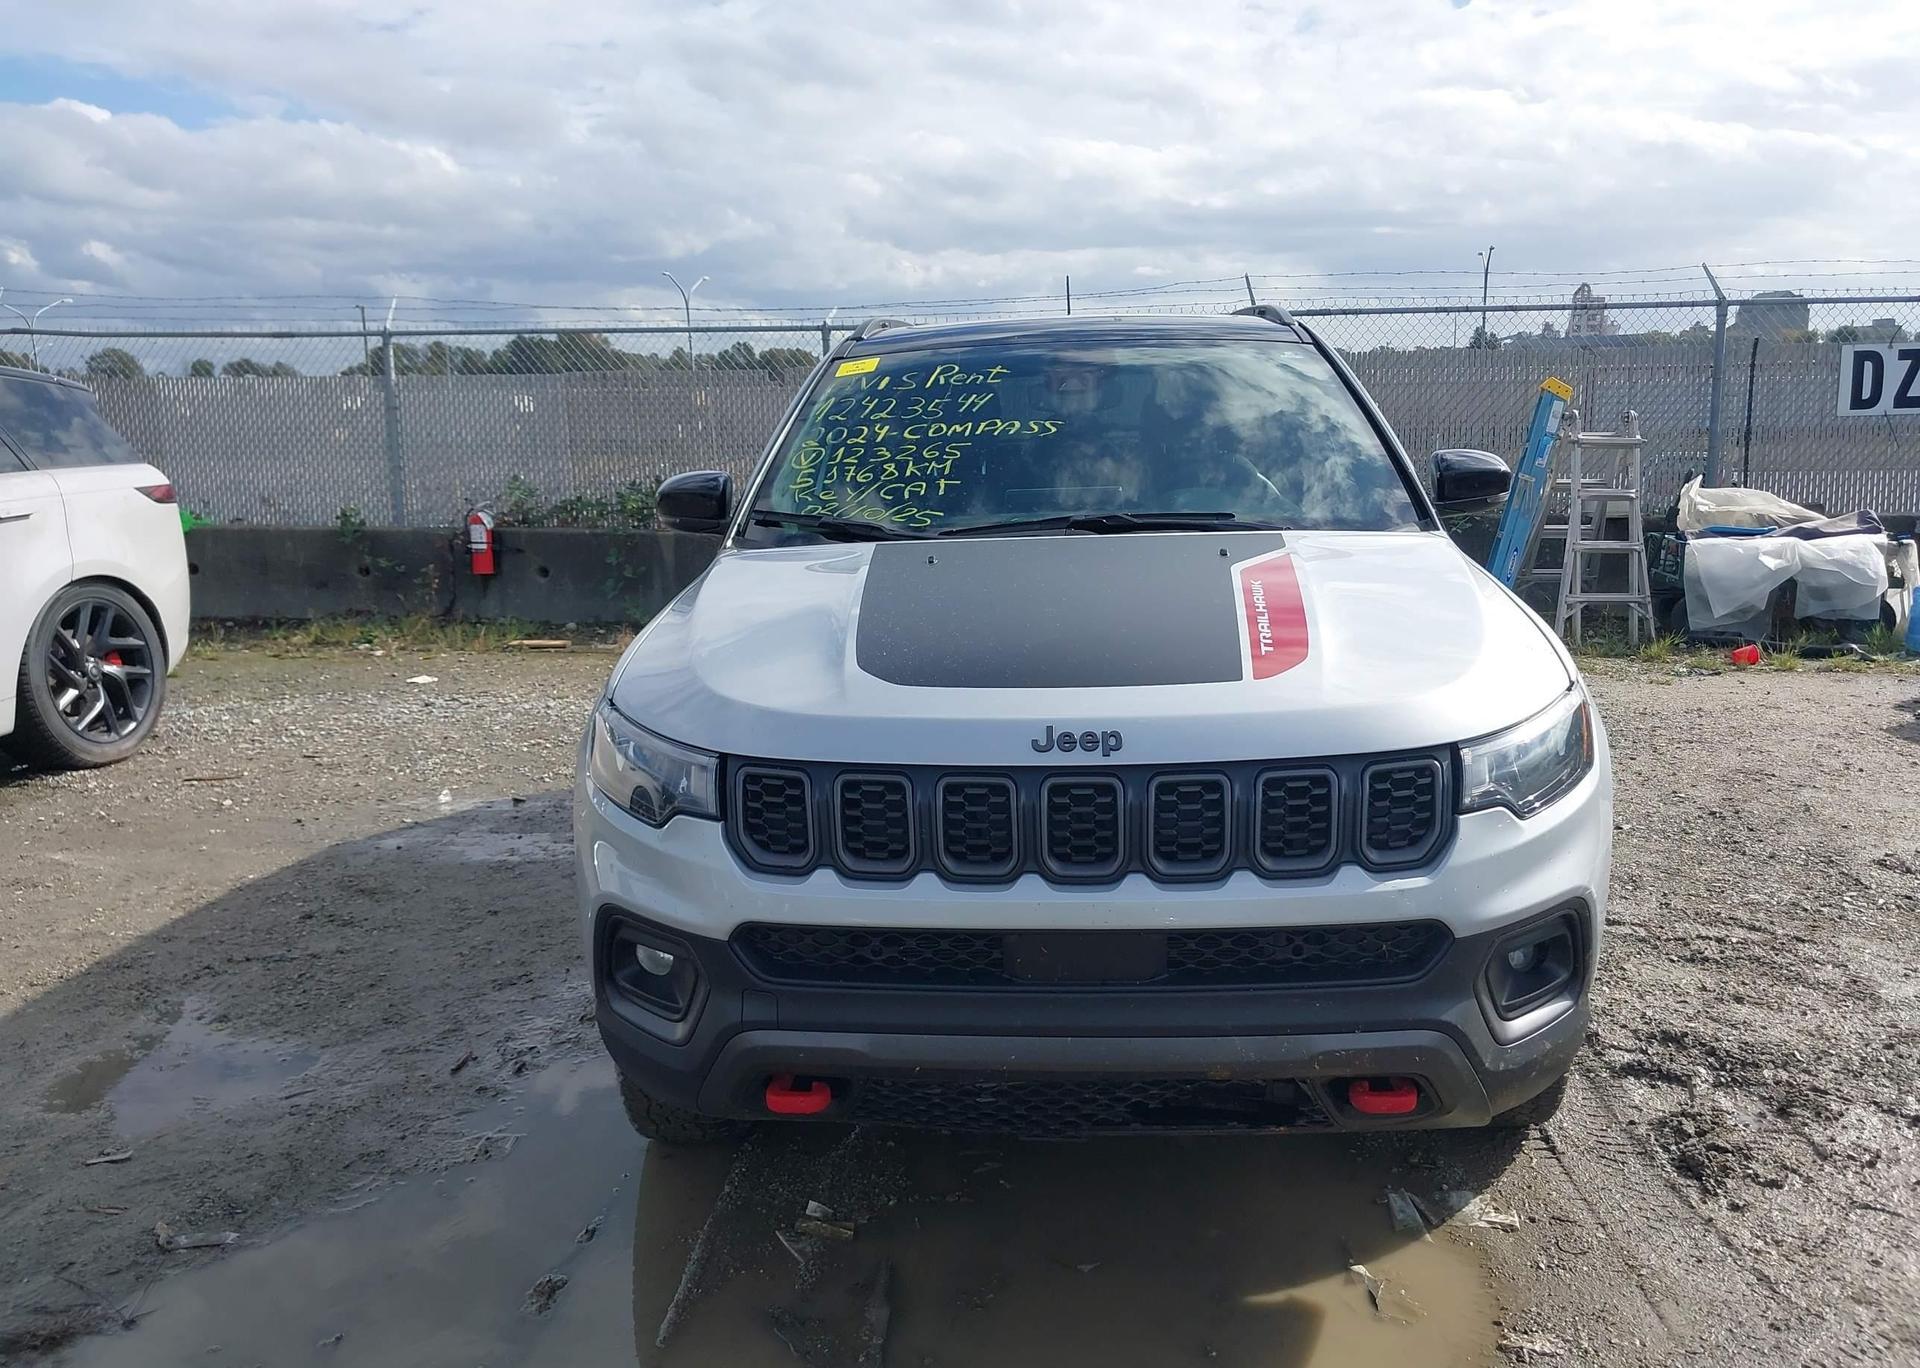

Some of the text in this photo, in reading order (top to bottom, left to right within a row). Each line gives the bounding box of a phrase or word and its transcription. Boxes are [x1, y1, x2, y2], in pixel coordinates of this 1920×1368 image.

[925, 364, 1011, 389] Rent
[1849, 349, 1920, 411] DZ
[815, 393, 995, 422] 12423544
[1250, 579, 1274, 657] TRAILHAWK
[1031, 725, 1123, 757] Jeep
